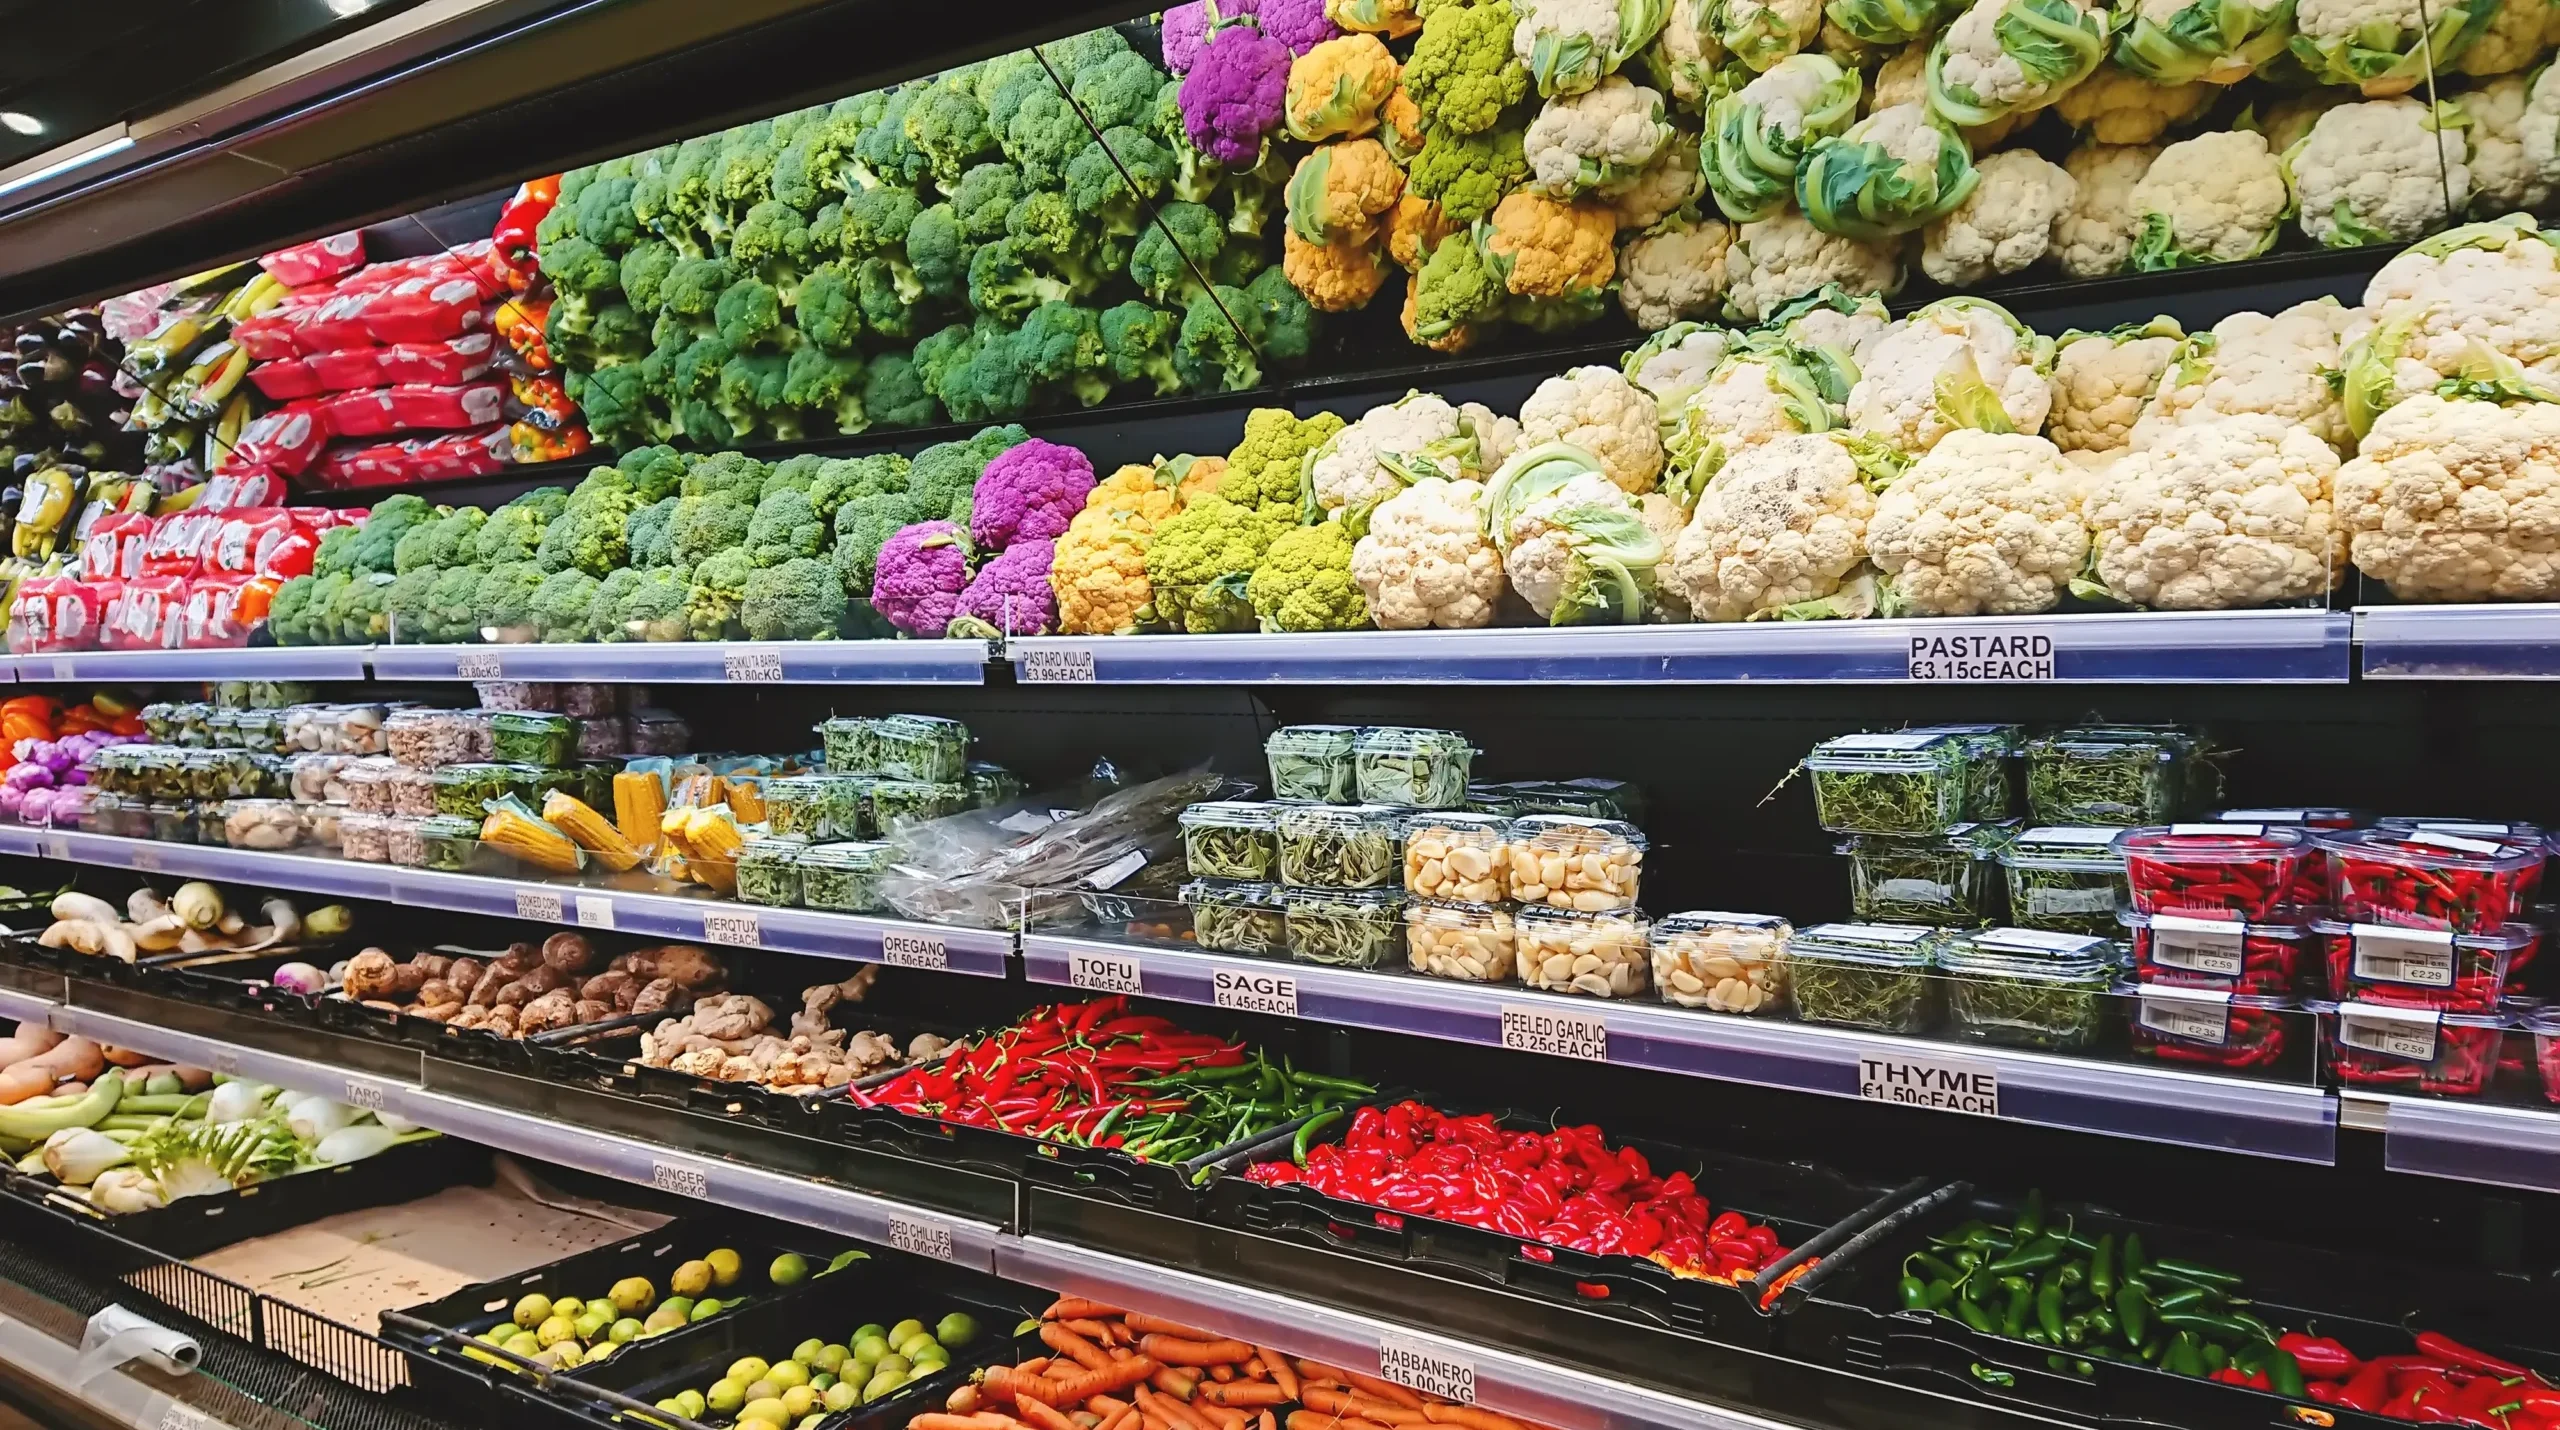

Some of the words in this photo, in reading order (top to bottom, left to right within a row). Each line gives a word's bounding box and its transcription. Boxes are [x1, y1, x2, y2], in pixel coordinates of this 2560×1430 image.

[1911, 635, 2051, 658] PASTARD
[1023, 652, 1062, 667] PASTARD
[1063, 651, 1092, 667] KULUR
[1910, 660, 2051, 679] €3.15cEACH
[459, 666, 500, 678] €3.80cKG
[728, 668, 781, 681] €3.80cKG
[1026, 668, 1094, 681] €3.99cEACH
[705, 917, 757, 933] MERQTUX
[885, 936, 946, 957] OREGANO
[1078, 958, 1132, 979] TOFU
[1073, 974, 1141, 995] €2.40cEACH
[1215, 973, 1294, 998] SAGE
[1218, 992, 1296, 1015] €1.45cEACH
[1503, 1012, 1553, 1037] PEELED
[1556, 1019, 1605, 1044] GARLIC
[1506, 1032, 1605, 1060] €3.25cEACH
[2395, 1042, 2425, 1054] €2.59
[1861, 1059, 1995, 1097] THYME
[654, 1165, 706, 1187] GINGER
[657, 1177, 707, 1199] €3.99cKG
[890, 1219, 908, 1235] RED
[910, 1224, 951, 1246] CHILLIES
[891, 1233, 952, 1259] €10.00cKG
[1381, 1345, 1473, 1385] HABBANERO
[1382, 1365, 1474, 1403] €15.00cKG
